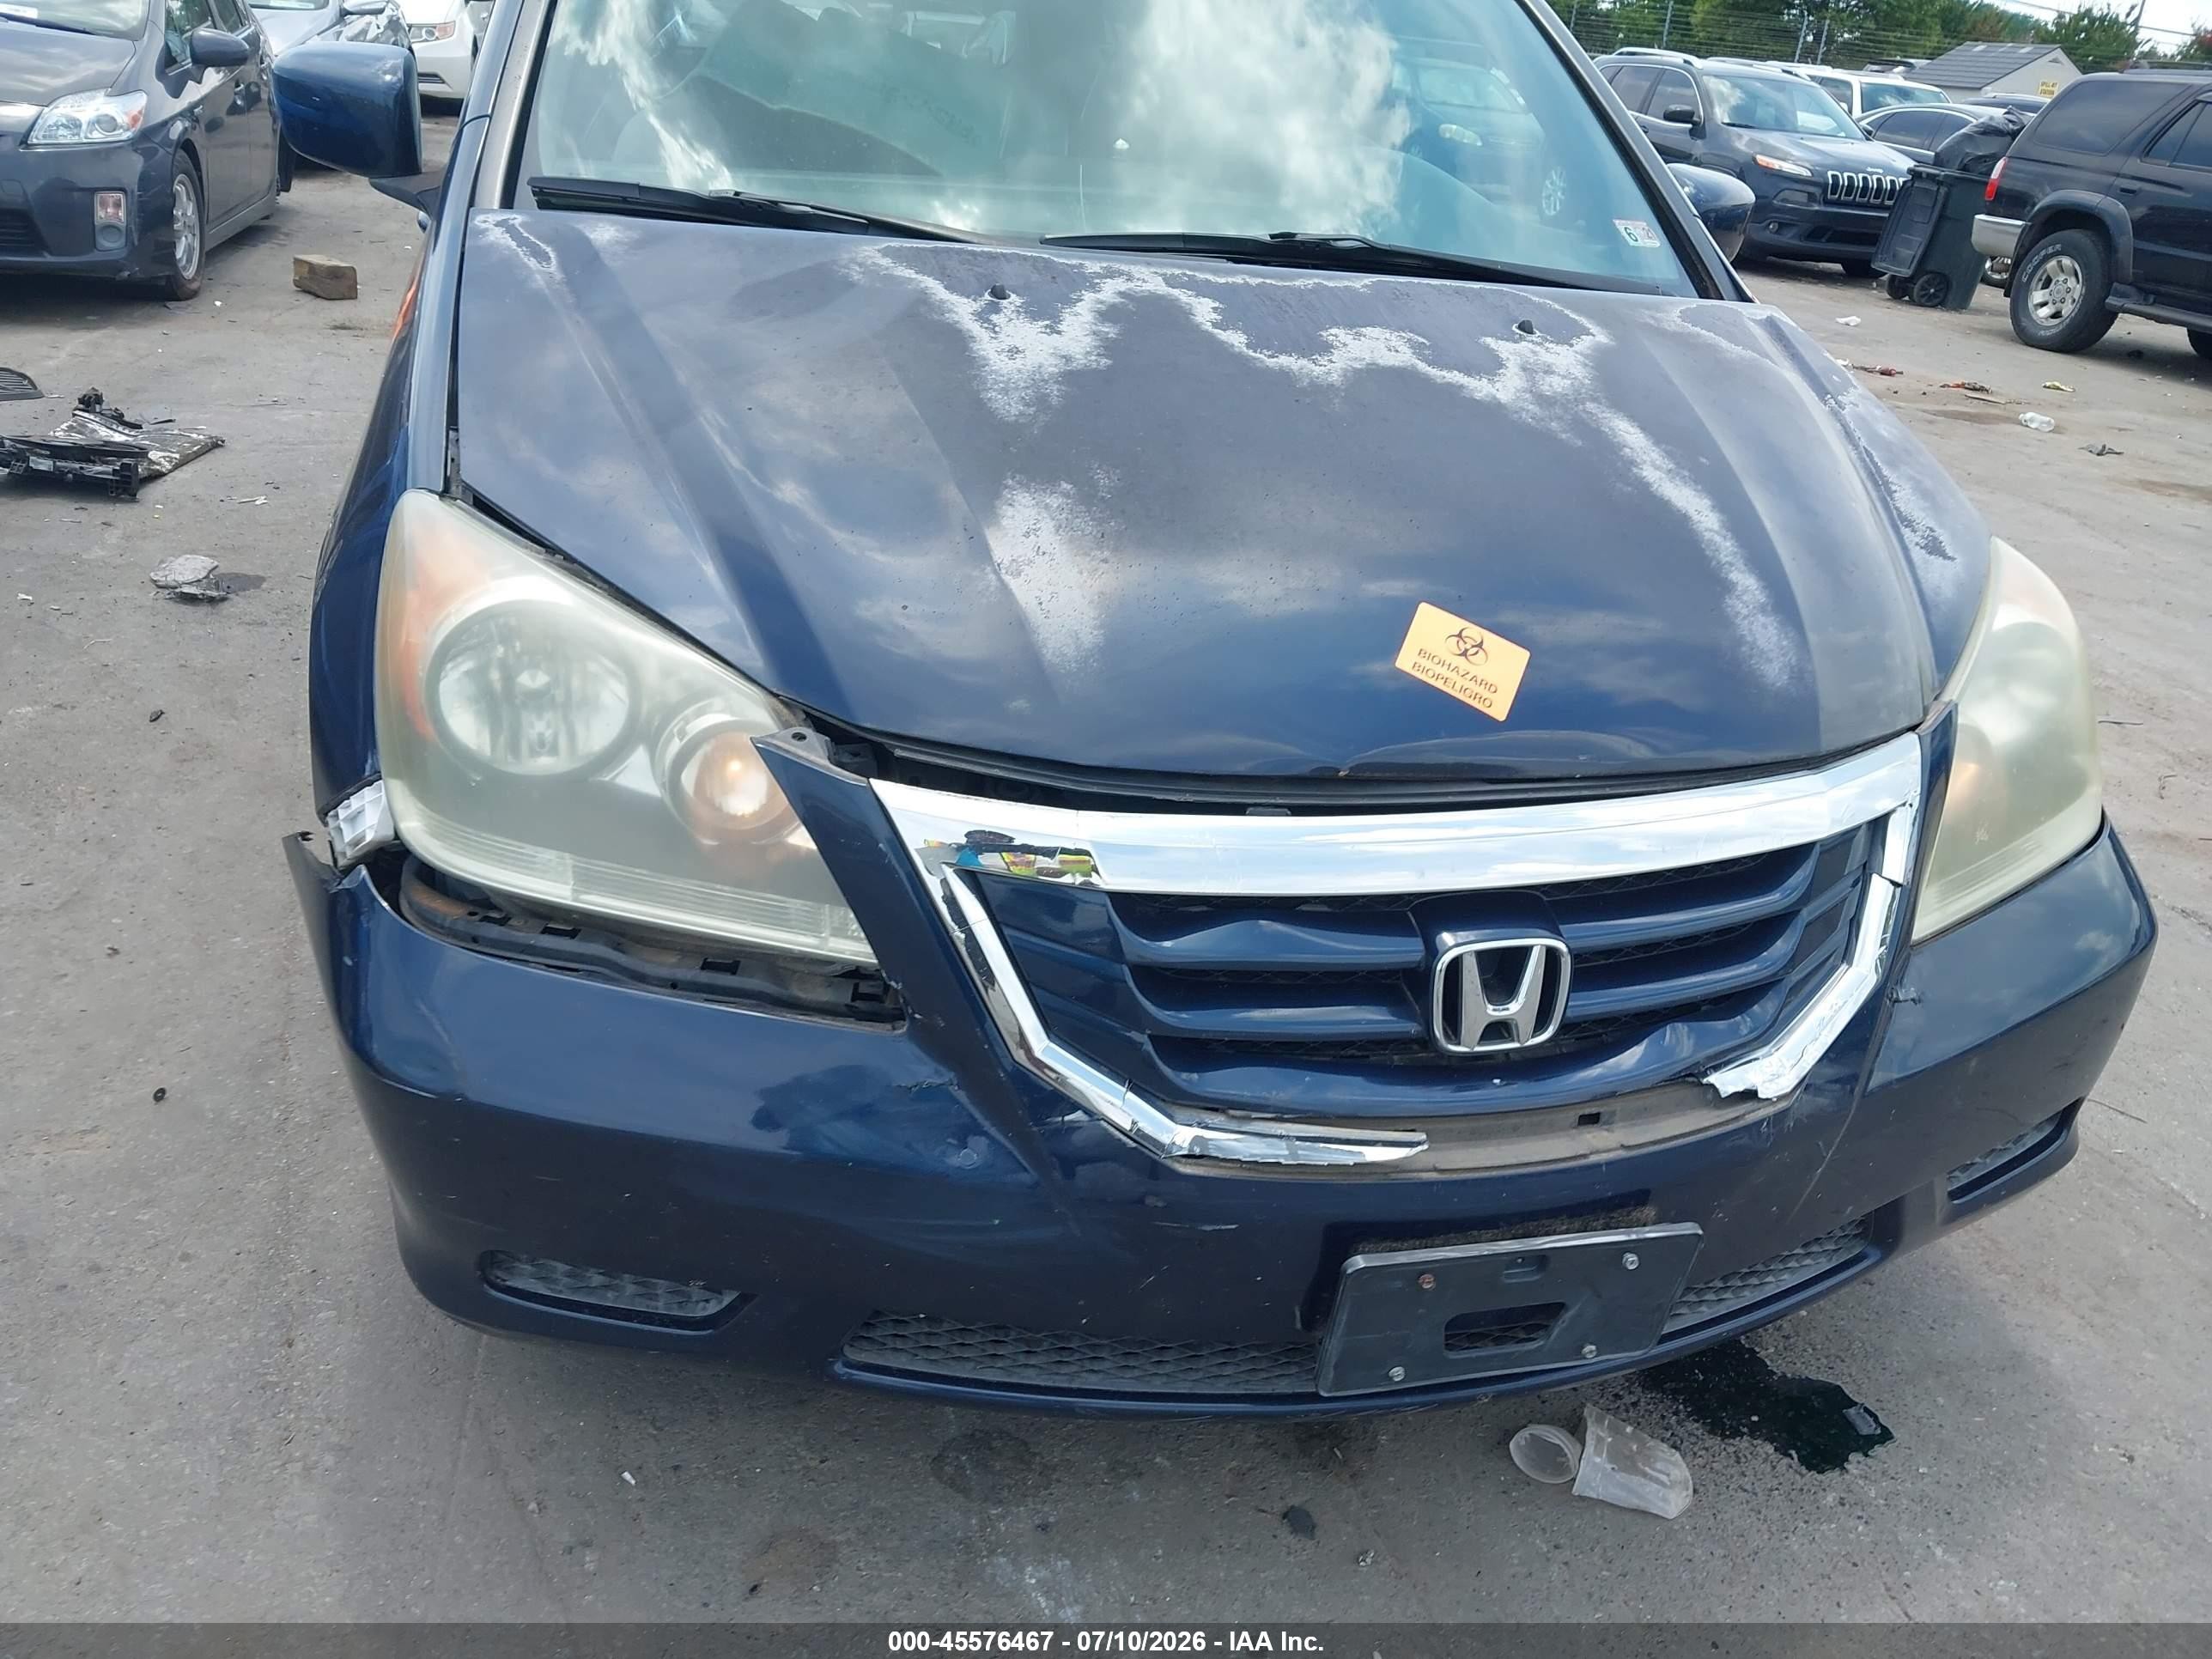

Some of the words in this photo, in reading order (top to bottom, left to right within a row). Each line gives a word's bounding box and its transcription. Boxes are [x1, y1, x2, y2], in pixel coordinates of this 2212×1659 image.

[1624, 226, 1639, 242] 6
[2021, 244, 2062, 283] COOPER
[1411, 661, 1493, 709] BIOPELIGRO
[1417, 647, 1498, 695] BIOHAZARD
